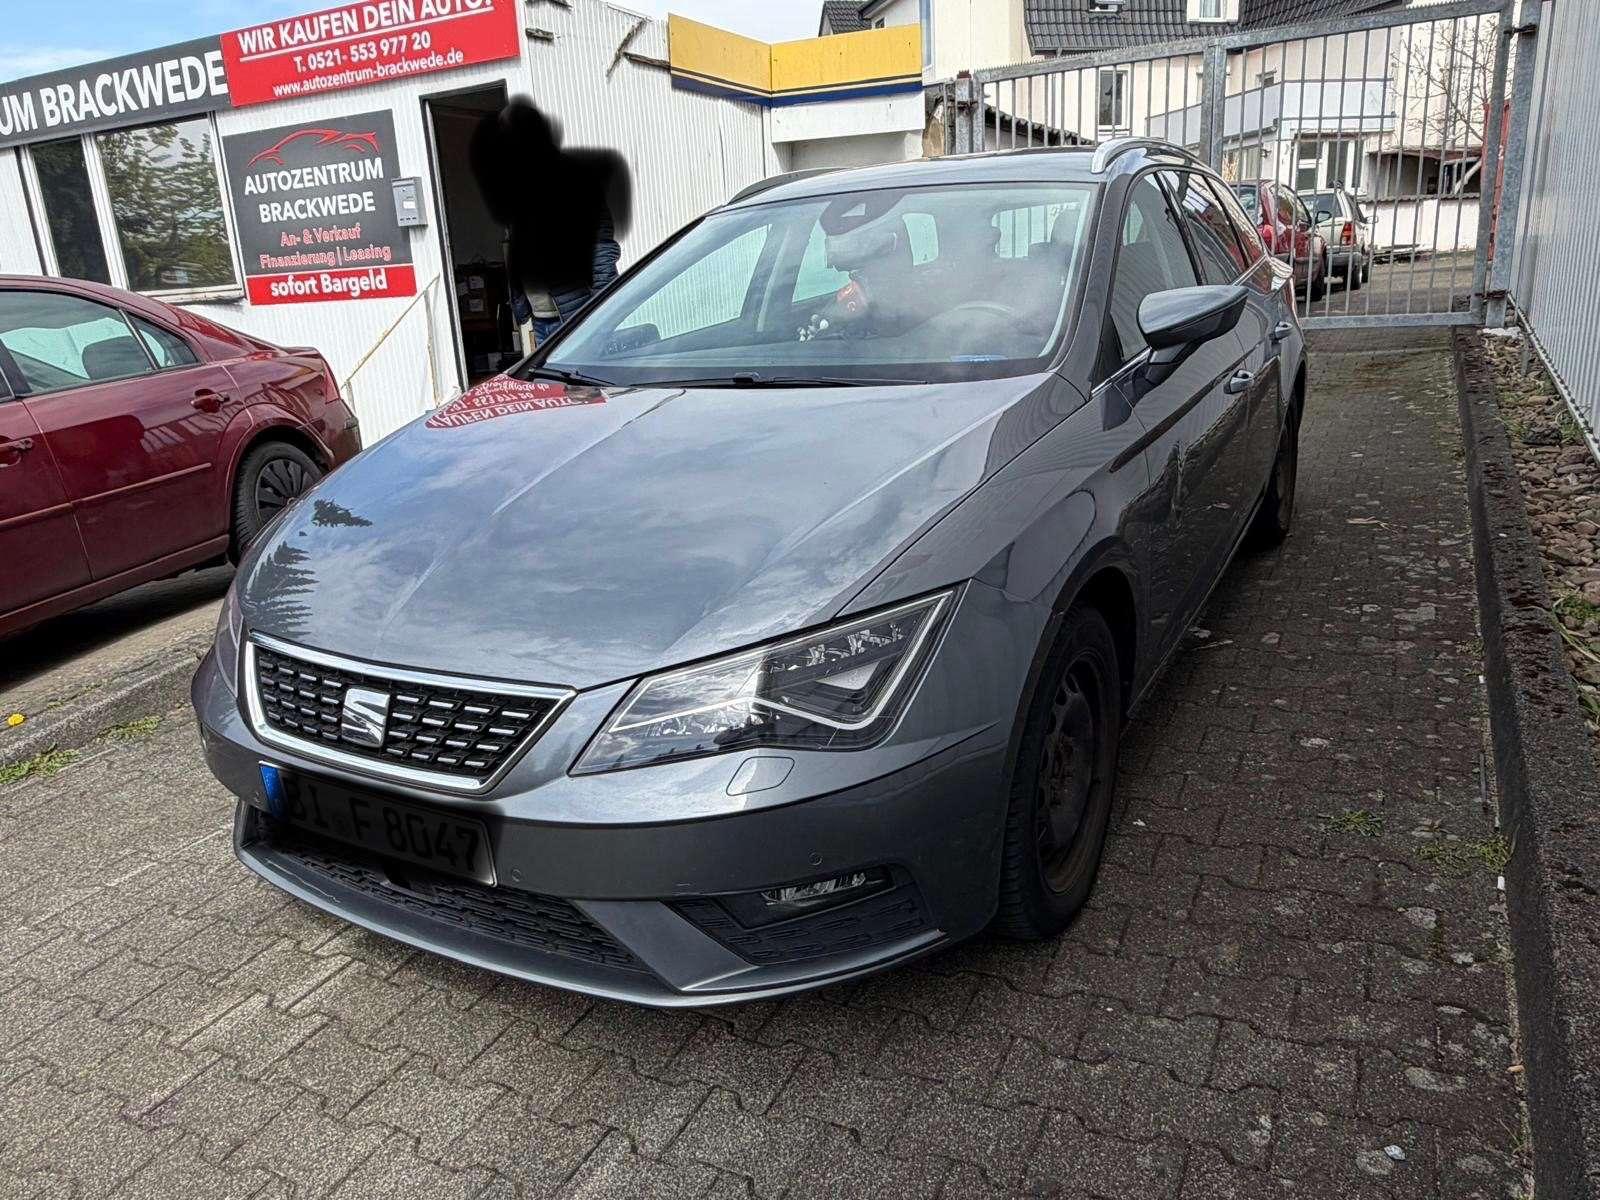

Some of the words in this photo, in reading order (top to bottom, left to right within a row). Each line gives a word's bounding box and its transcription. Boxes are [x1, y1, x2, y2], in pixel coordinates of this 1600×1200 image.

[238, 31, 275, 54] WIR
[279, 11, 358, 48] KAUFEN
[363, 0, 415, 28] DEIN
[294, 57, 307, 73] T.
[349, 41, 377, 62] 553
[381, 36, 407, 56] 977
[412, 30, 431, 50] 20
[273, 49, 464, 97] www.autozentrum-brackwede.de
[0, 91, 38, 136] UM
[40, 50, 229, 127] BRACKWEDE
[244, 157, 384, 195] AUTOZENTRUM
[259, 191, 376, 223] BRACKWEDE
[280, 232, 301, 247] An-
[303, 229, 312, 245] &
[314, 222, 362, 244] Verkauf
[260, 248, 335, 269] Finanzierung
[343, 244, 392, 263] Leasing
[270, 274, 318, 297] sofort
[320, 268, 388, 297] Bargeld
